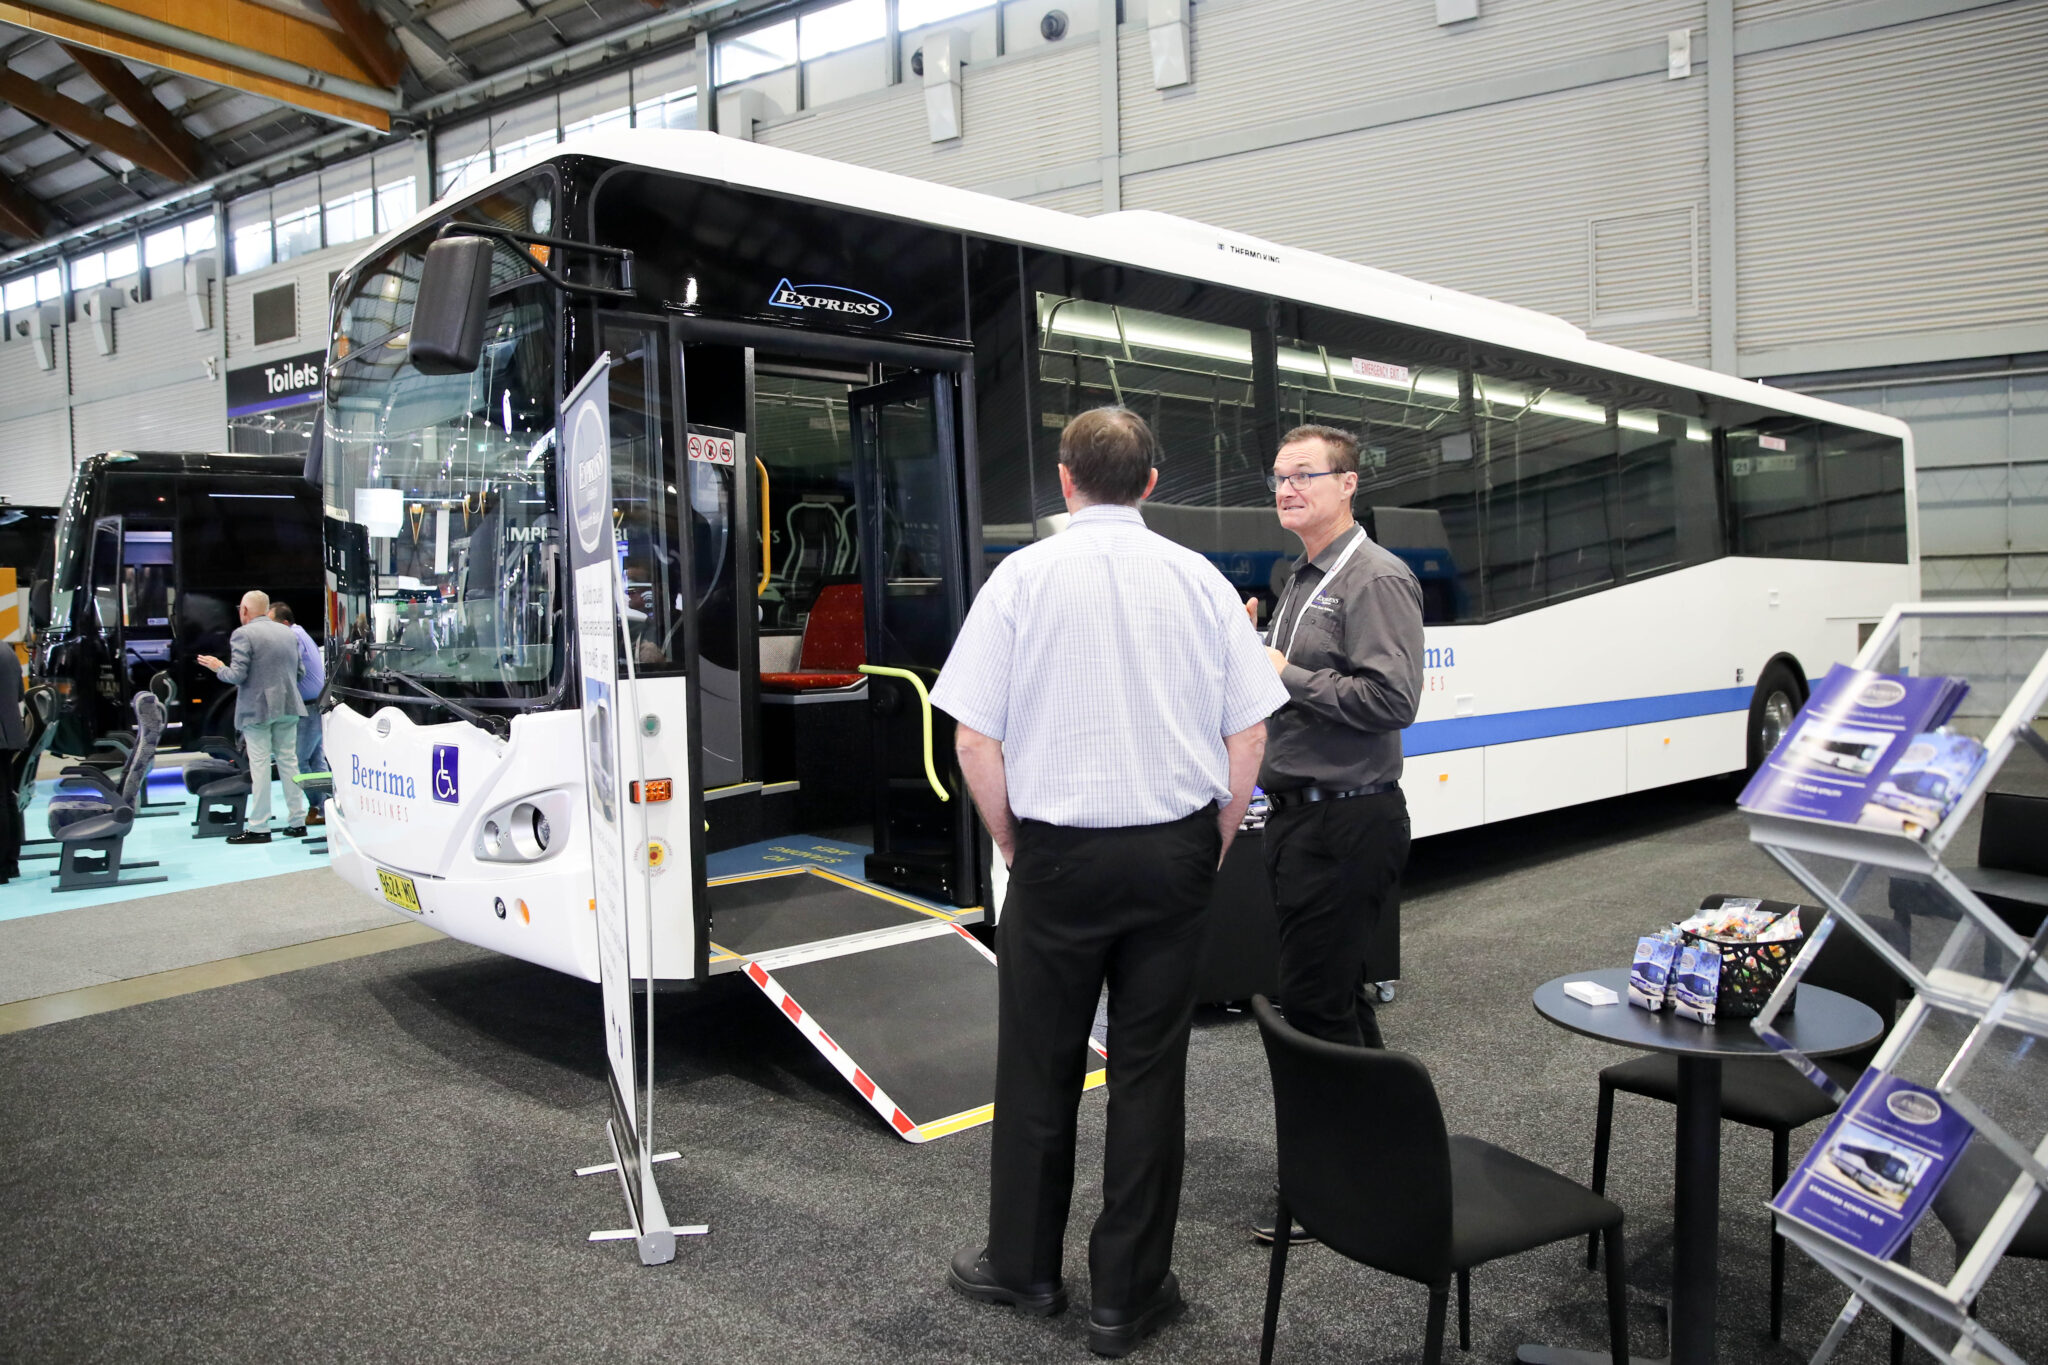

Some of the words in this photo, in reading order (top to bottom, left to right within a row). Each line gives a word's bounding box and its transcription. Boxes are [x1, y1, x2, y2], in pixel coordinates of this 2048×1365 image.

[776, 289, 880, 316] EXPRESS
[264, 362, 319, 394] Toilets
[351, 753, 416, 800] Berrima
[360, 795, 409, 823] BUSLINES
